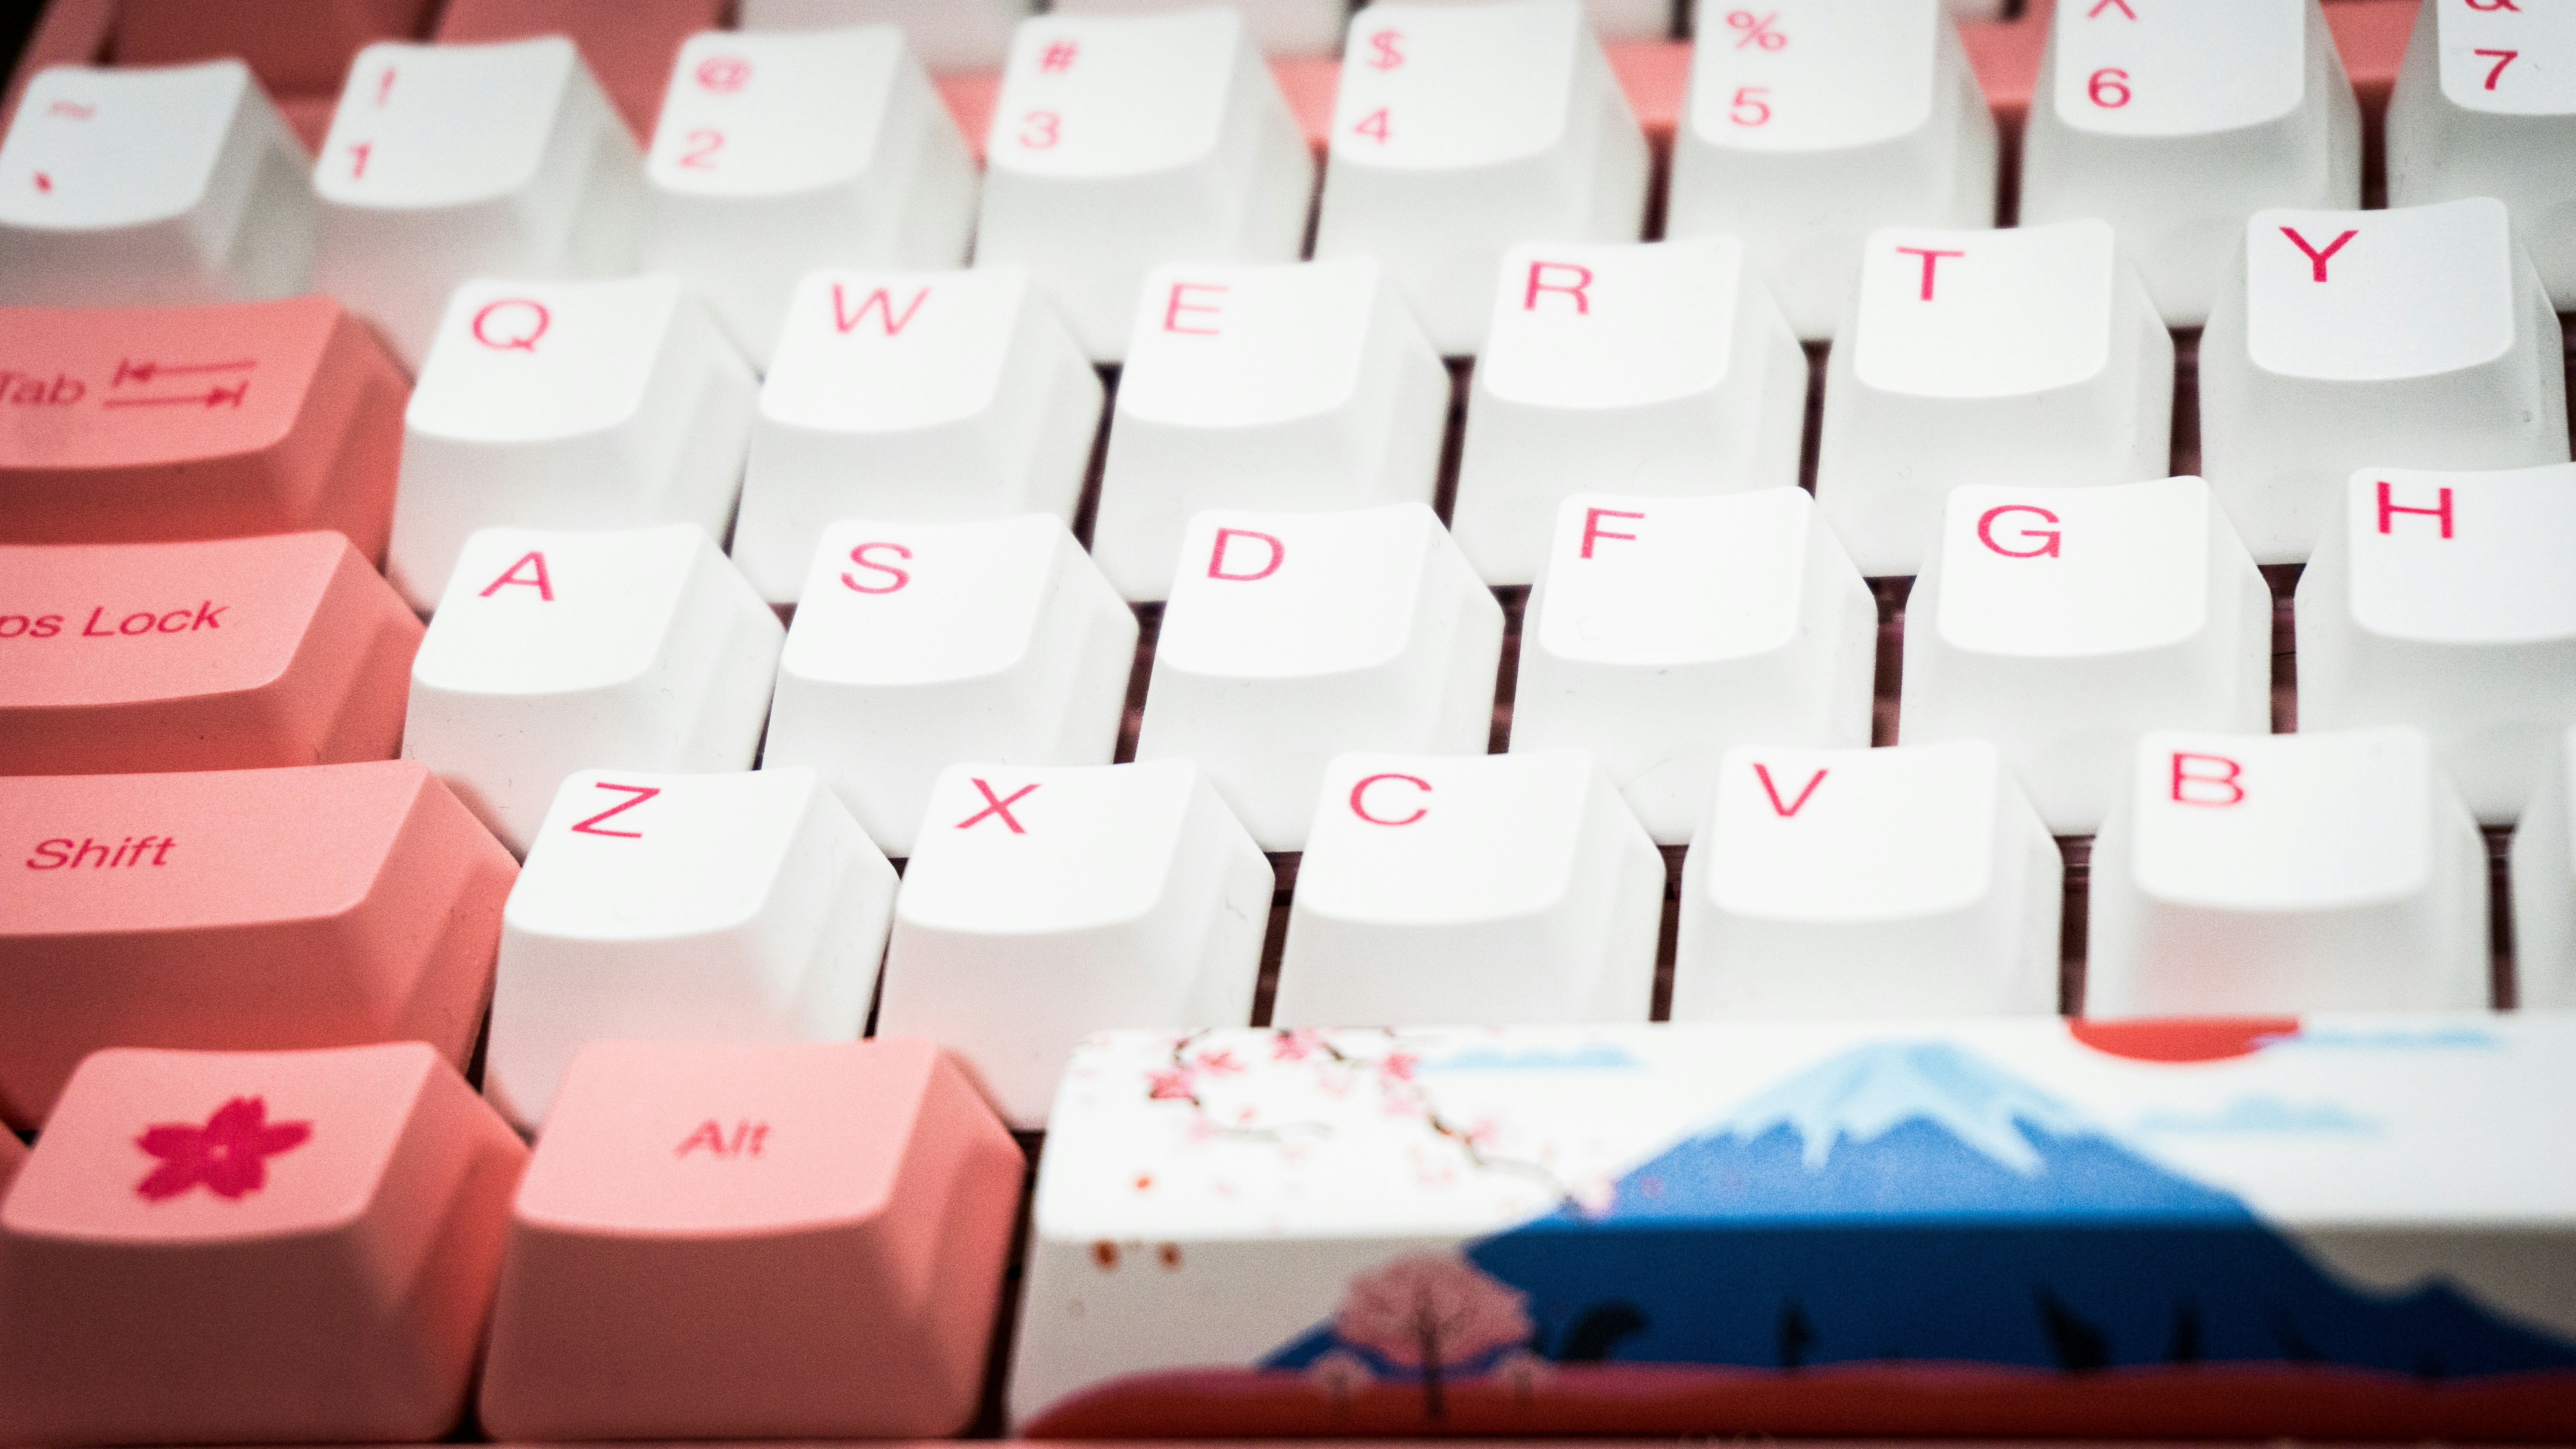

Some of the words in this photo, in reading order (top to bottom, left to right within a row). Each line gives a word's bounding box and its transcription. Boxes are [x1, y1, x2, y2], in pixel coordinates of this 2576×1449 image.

[1368, 29, 1405, 70] $
[1725, 10, 1788, 52] %
[694, 56, 753, 95] @
[1038, 39, 1078, 74] #
[2473, 48, 2519, 92] 7
[375, 67, 398, 108] !
[1730, 87, 1772, 126] 5
[2087, 68, 2132, 109] 6
[678, 128, 726, 170] 2
[1019, 110, 1061, 149] 3
[1352, 107, 1391, 144] 4
[347, 141, 372, 181] 1
[1898, 247, 1962, 302] T
[2279, 226, 2358, 284] Y
[831, 284, 928, 336] W
[1163, 282, 1230, 335] E
[1524, 261, 1593, 315] R
[471, 302, 551, 352] Q
[1580, 507, 1645, 560] F
[1976, 504, 2061, 559] G
[2376, 480, 2454, 540] H
[479, 551, 554, 602] A
[840, 543, 912, 595] S
[1207, 527, 1285, 582] D
[82, 600, 230, 637] Lock
[1349, 773, 1433, 827] C
[1753, 763, 1829, 818] V
[2170, 751, 2245, 806] B
[571, 781, 662, 839] Z
[956, 777, 1039, 835] X
[26, 835, 176, 870] Shift
[675, 1119, 773, 1159] Alt
